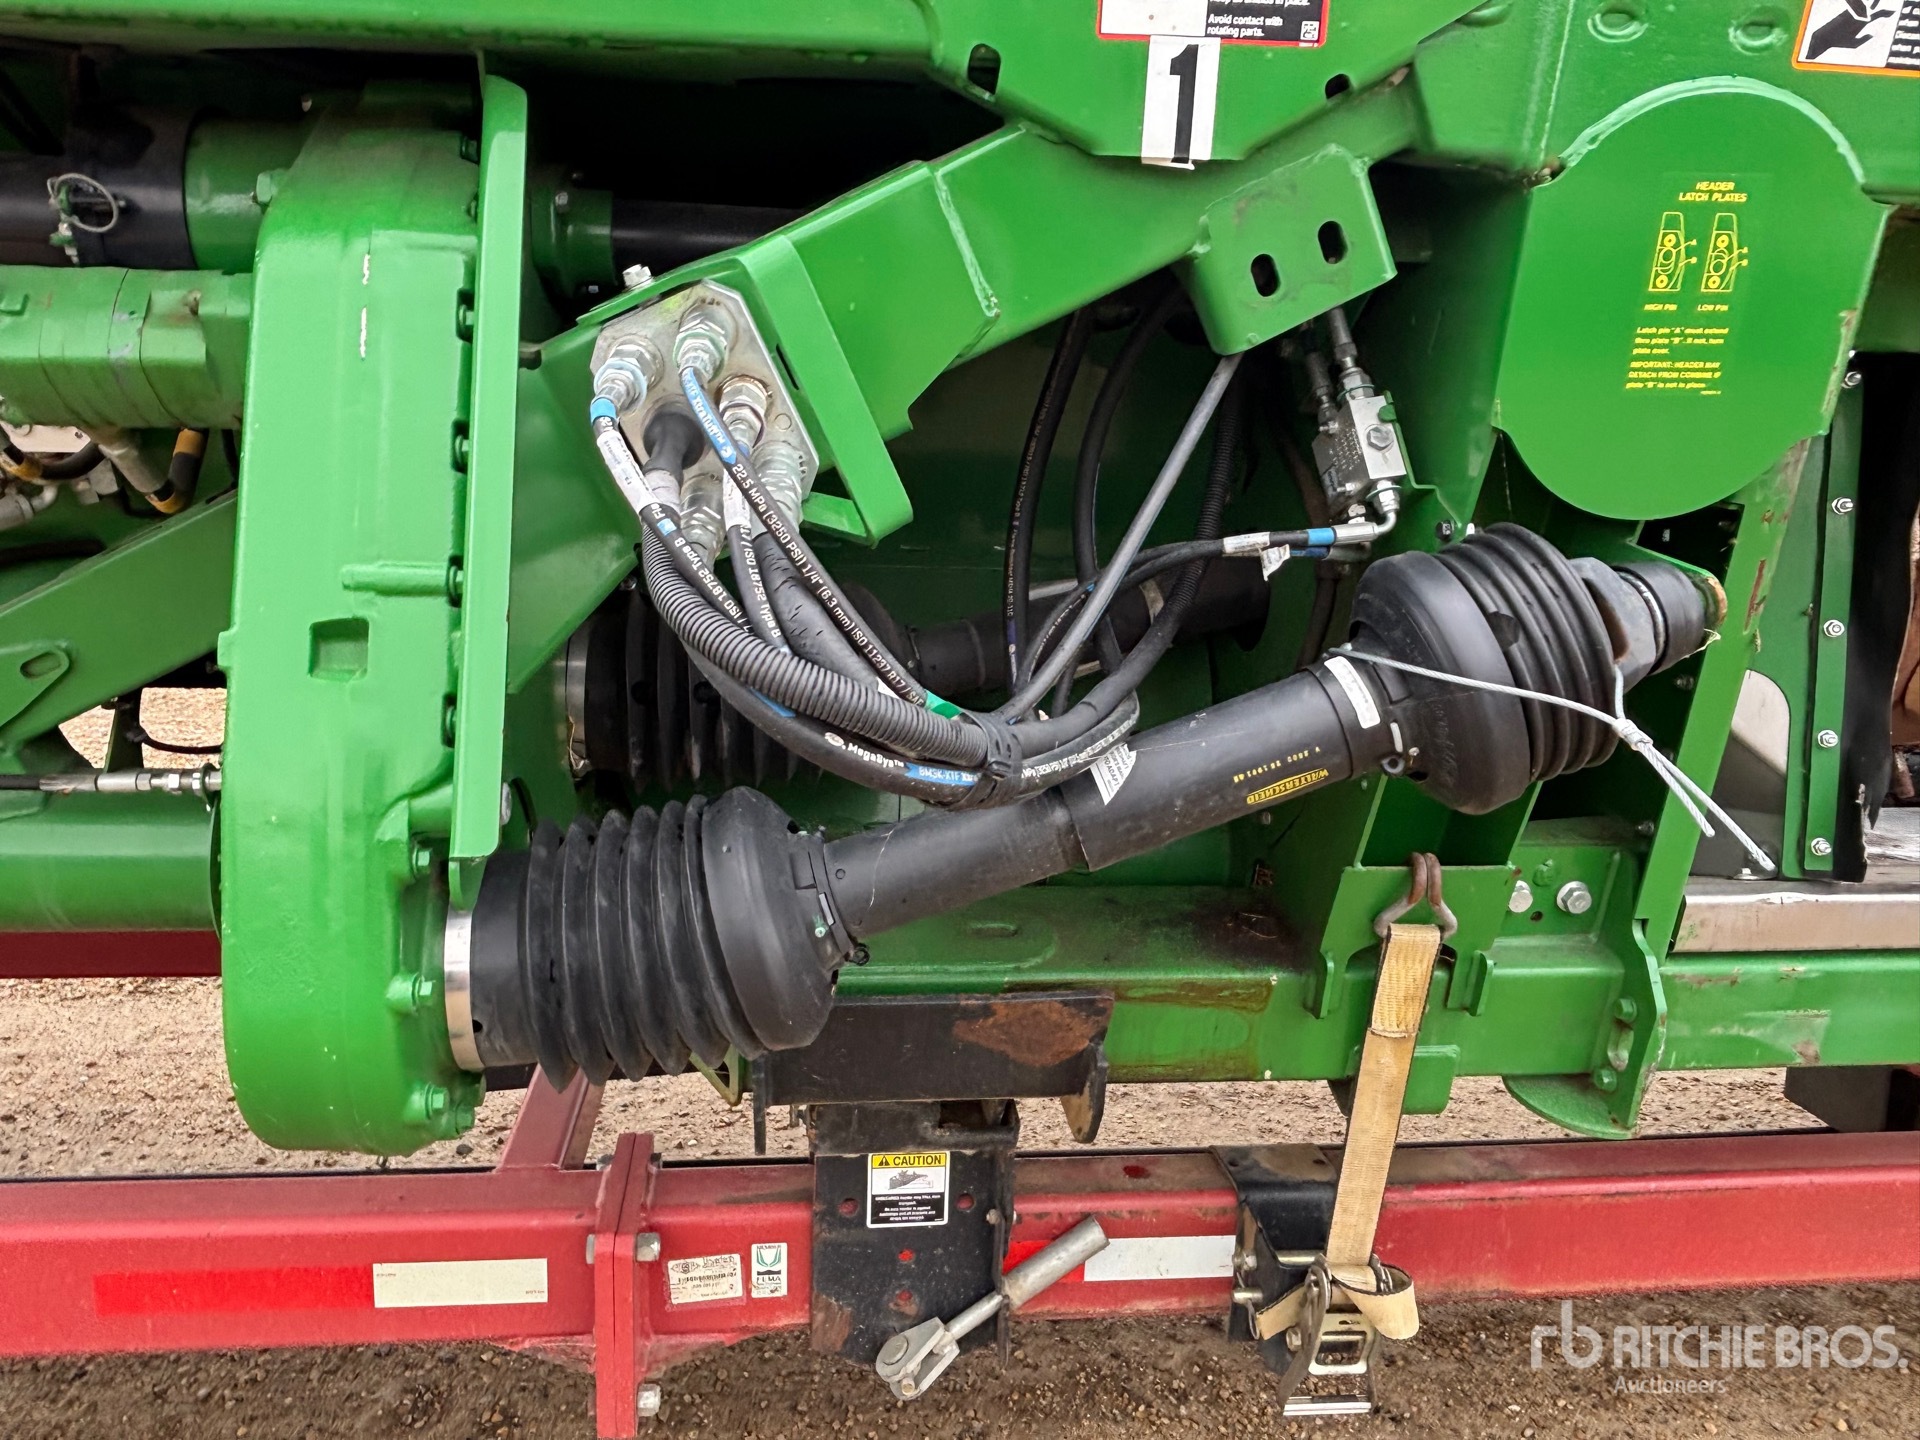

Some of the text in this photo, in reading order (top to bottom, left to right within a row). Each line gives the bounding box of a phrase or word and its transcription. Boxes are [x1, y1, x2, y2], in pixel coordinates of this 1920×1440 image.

[1208, 14, 1283, 26] Avoid contact with
[1207, 26, 1265, 38] rotating parts.
[1170, 44, 1199, 163] 1
[1696, 182, 1735, 191] HEADER
[1679, 192, 1748, 202] LATCH PLATES
[674, 536, 686, 548] B
[687, 542, 702, 571] Type
[744, 545, 757, 566] ISO
[698, 568, 727, 602] 18752
[732, 463, 752, 490] 22.5
[749, 487, 767, 512] MPa
[764, 509, 790, 544] (3250
[786, 541, 806, 566] PSI)
[833, 606, 855, 631] mm)
[851, 627, 869, 648] ISO
[861, 643, 890, 673] 11237
[887, 669, 904, 692] R17
[748, 566, 766, 601] 18752
[724, 602, 743, 619] ISO
[760, 603, 777, 629] Type
[770, 626, 782, 638] B
[1247, 768, 1329, 804] WALTERSCHEID
[893, 1155, 941, 1166] CAUTION
